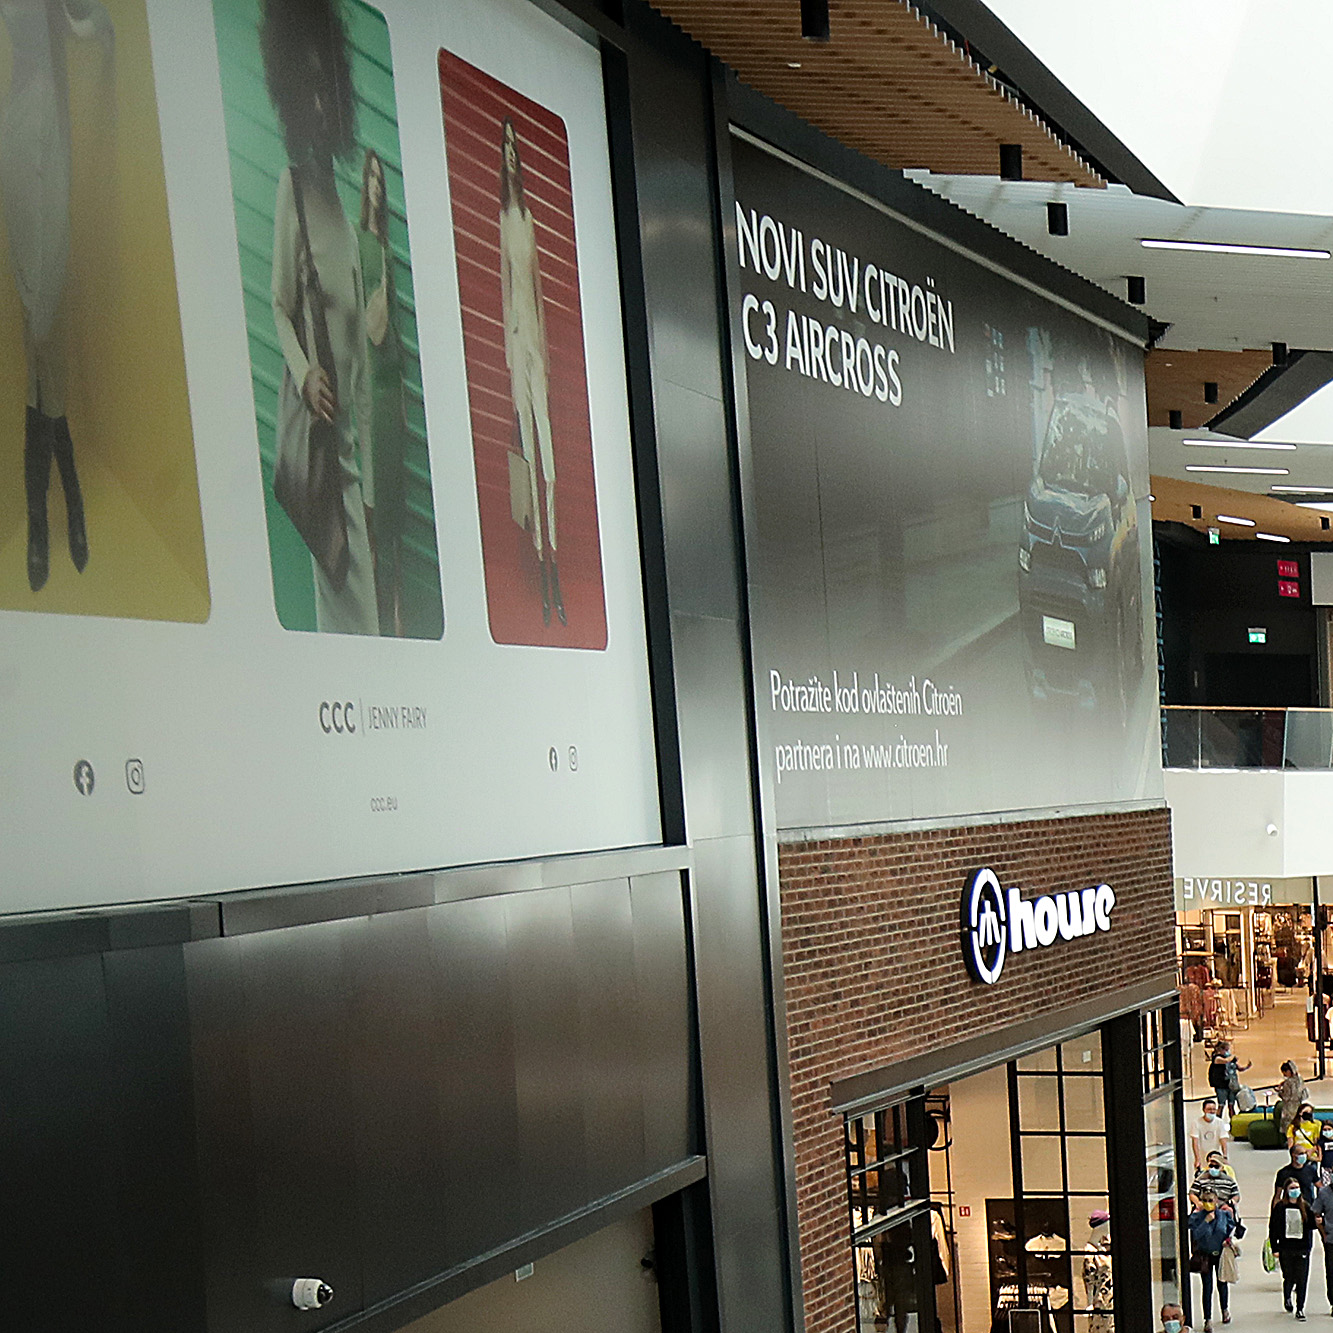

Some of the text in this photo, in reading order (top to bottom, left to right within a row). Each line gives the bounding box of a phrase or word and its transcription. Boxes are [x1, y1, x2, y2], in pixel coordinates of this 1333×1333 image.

[736, 201, 954, 353] NOVI SUV CITROËN
[742, 294, 902, 407] C3 AIRCROSS
[770, 669, 832, 713] Potražite
[833, 671, 859, 713] kod
[862, 673, 921, 714] ovlaštenih
[319, 702, 427, 733] CCC JENNY FAIRY
[775, 729, 948, 784] partnera i na www.citroen.hr
[370, 797, 398, 811] ccc.eu
